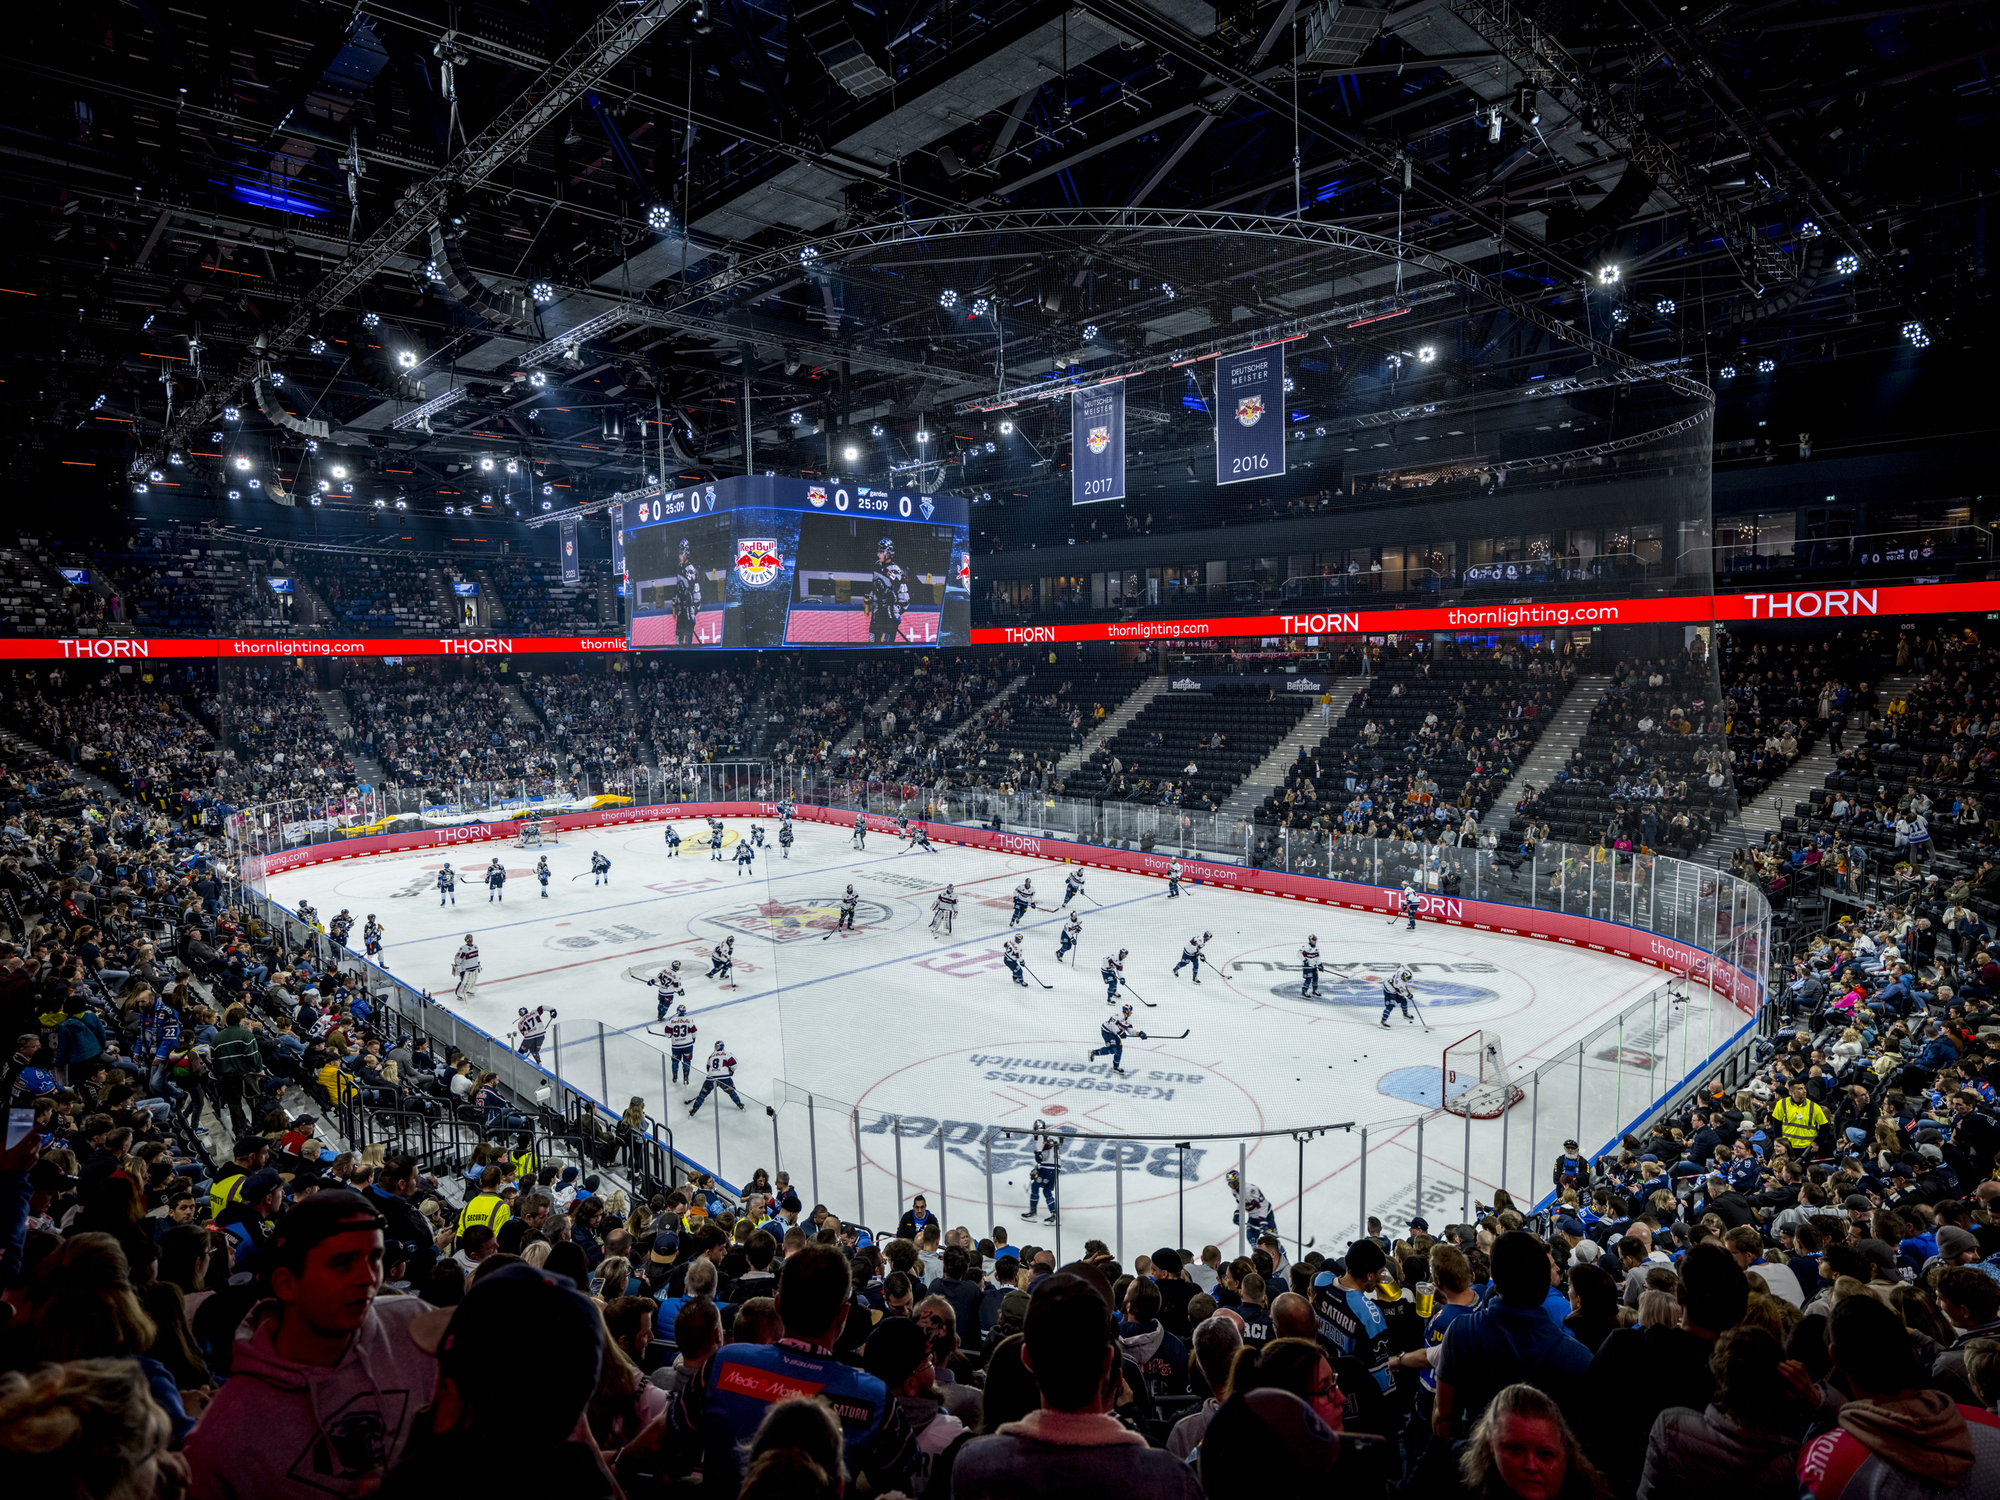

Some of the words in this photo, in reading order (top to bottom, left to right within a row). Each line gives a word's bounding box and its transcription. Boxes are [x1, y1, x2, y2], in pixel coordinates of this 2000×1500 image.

[1232, 361, 1268, 377] DEUTSCHER
[1231, 370, 1268, 386] MEISTER
[1084, 396, 1113, 409] DEUTSCHER
[1084, 404, 1113, 416] MEISTER
[1232, 453, 1269, 473] 2016
[858, 487, 869, 496] SAP
[869, 490, 888, 498] garden
[1084, 478, 1113, 495] 2017
[665, 500, 685, 515] 25:09
[690, 491, 700, 513] 0
[834, 489, 849, 511] 0
[858, 499, 889, 511] 25:09
[899, 496, 912, 517] 0
[653, 500, 661, 521] 0
[740, 542, 755, 552] Red
[755, 542, 774, 551] Bull
[742, 568, 774, 584] MÜNCHEN
[1744, 590, 1877, 618] THORN
[1280, 613, 1358, 633] THORN
[1448, 606, 1618, 626] thornlighting.com
[1005, 627, 1054, 642] THORN
[1108, 623, 1208, 638] thornlighting.com
[58, 640, 148, 657] THORN
[234, 641, 364, 655] thornlighting.com
[440, 639, 512, 653] THORN
[1172, 680, 1201, 692] Bergader
[1286, 680, 1321, 693] Bergader
[601, 805, 681, 820] thornlighting.com
[435, 825, 492, 842] THORN
[1910, 821, 1922, 834] 11
[998, 834, 1041, 852] THORN
[1144, 857, 1238, 880] thornhting.com
[1422, 914, 1438, 922] PENNY.
[1446, 918, 1462, 926] PENNY.
[1500, 927, 1518, 935] PENNY.
[1530, 932, 1548, 940] PENNY.
[1558, 937, 1576, 945] PENNY.
[1588, 942, 1605, 951] PENNY.
[1614, 948, 1630, 958] PENNY.
[1231, 961, 1499, 975] SUBARU
[1641, 956, 1657, 966] PENNY.
[1650, 939, 1751, 998] thornlighting.om
[661, 975, 672, 987] 52
[523, 1017, 535, 1032] 17
[673, 1025, 687, 1038] 93
[165, 1028, 176, 1038] 22
[712, 1058, 720, 1070] 8
[968, 1052, 1140, 1082] Alpenmilch
[984, 1069, 1176, 1102] Käsegenuss
[1148, 1069, 1205, 1087] aus
[467, 1213, 488, 1222] SECURITY
[1320, 1301, 1357, 1334] SATURN
[790, 1358, 823, 1372] BAUER
[724, 1370, 759, 1390] Media
[765, 1382, 803, 1400] Mark
[832, 1403, 869, 1421] SATURN
